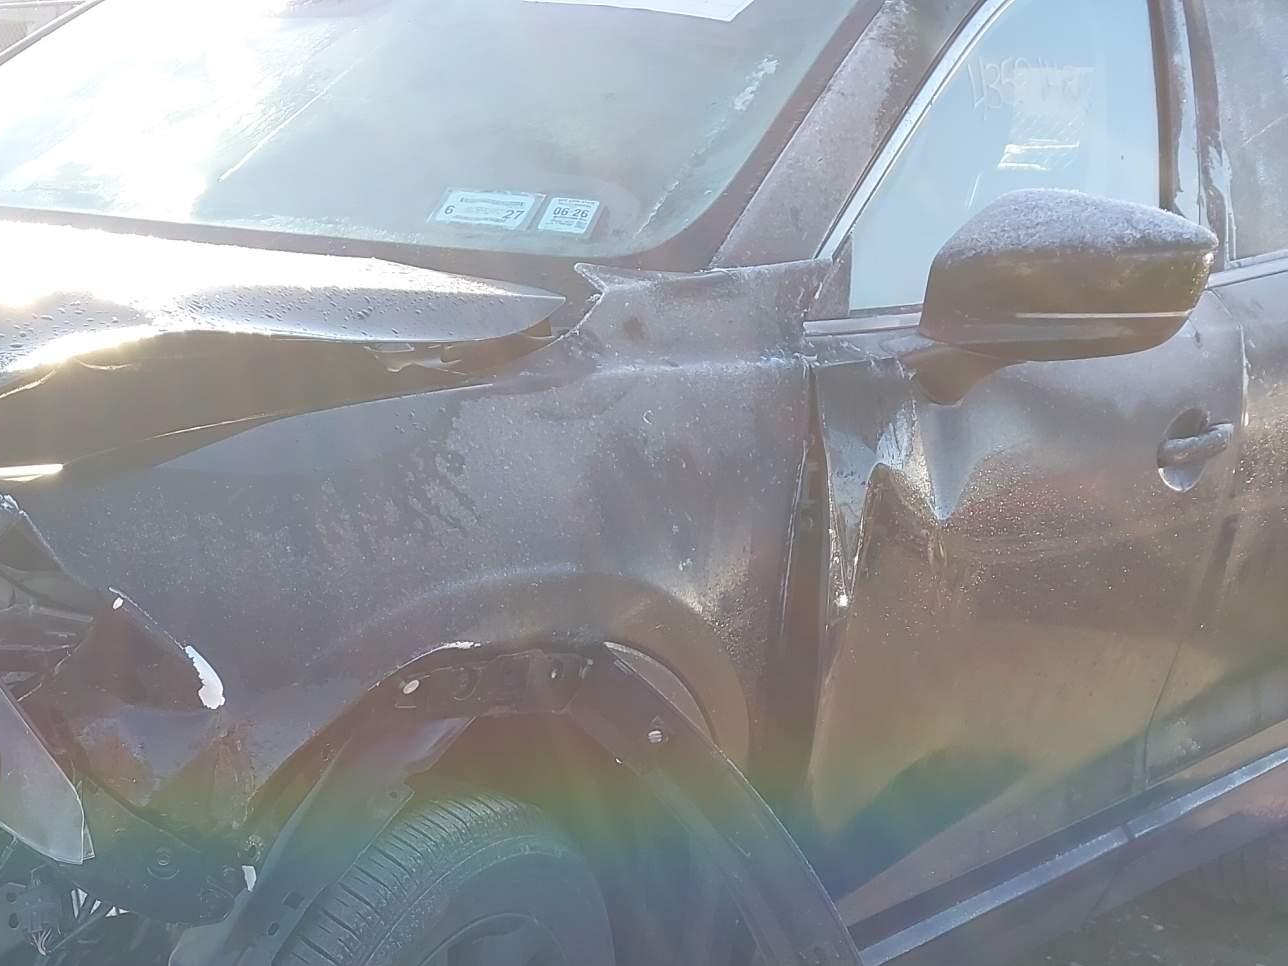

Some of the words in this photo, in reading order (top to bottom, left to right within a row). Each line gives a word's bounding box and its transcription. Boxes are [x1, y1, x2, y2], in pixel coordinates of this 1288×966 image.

[444, 204, 456, 215] 6
[501, 209, 525, 220] 27
[572, 208, 590, 218] 26
